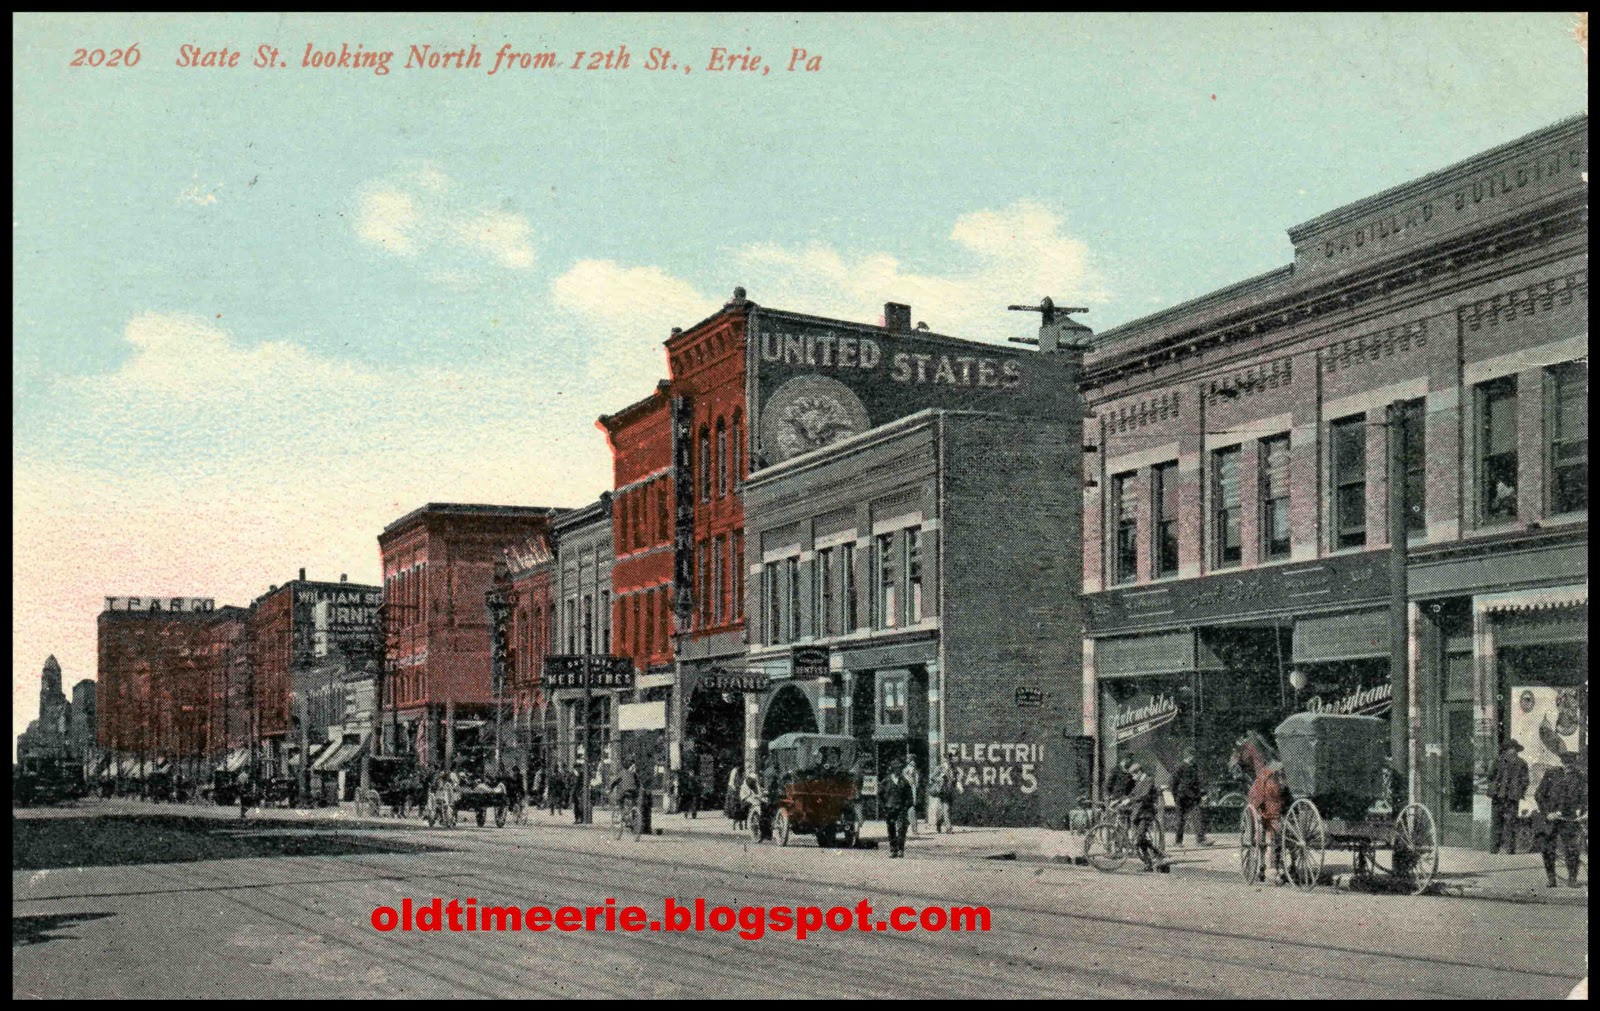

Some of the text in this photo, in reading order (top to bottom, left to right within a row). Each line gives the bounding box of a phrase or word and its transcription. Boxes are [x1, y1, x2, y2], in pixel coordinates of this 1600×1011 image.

[760, 332, 1021, 389] UNITED STATES
[298, 591, 361, 604] WILLIAM
[703, 676, 768, 690] GRAND
